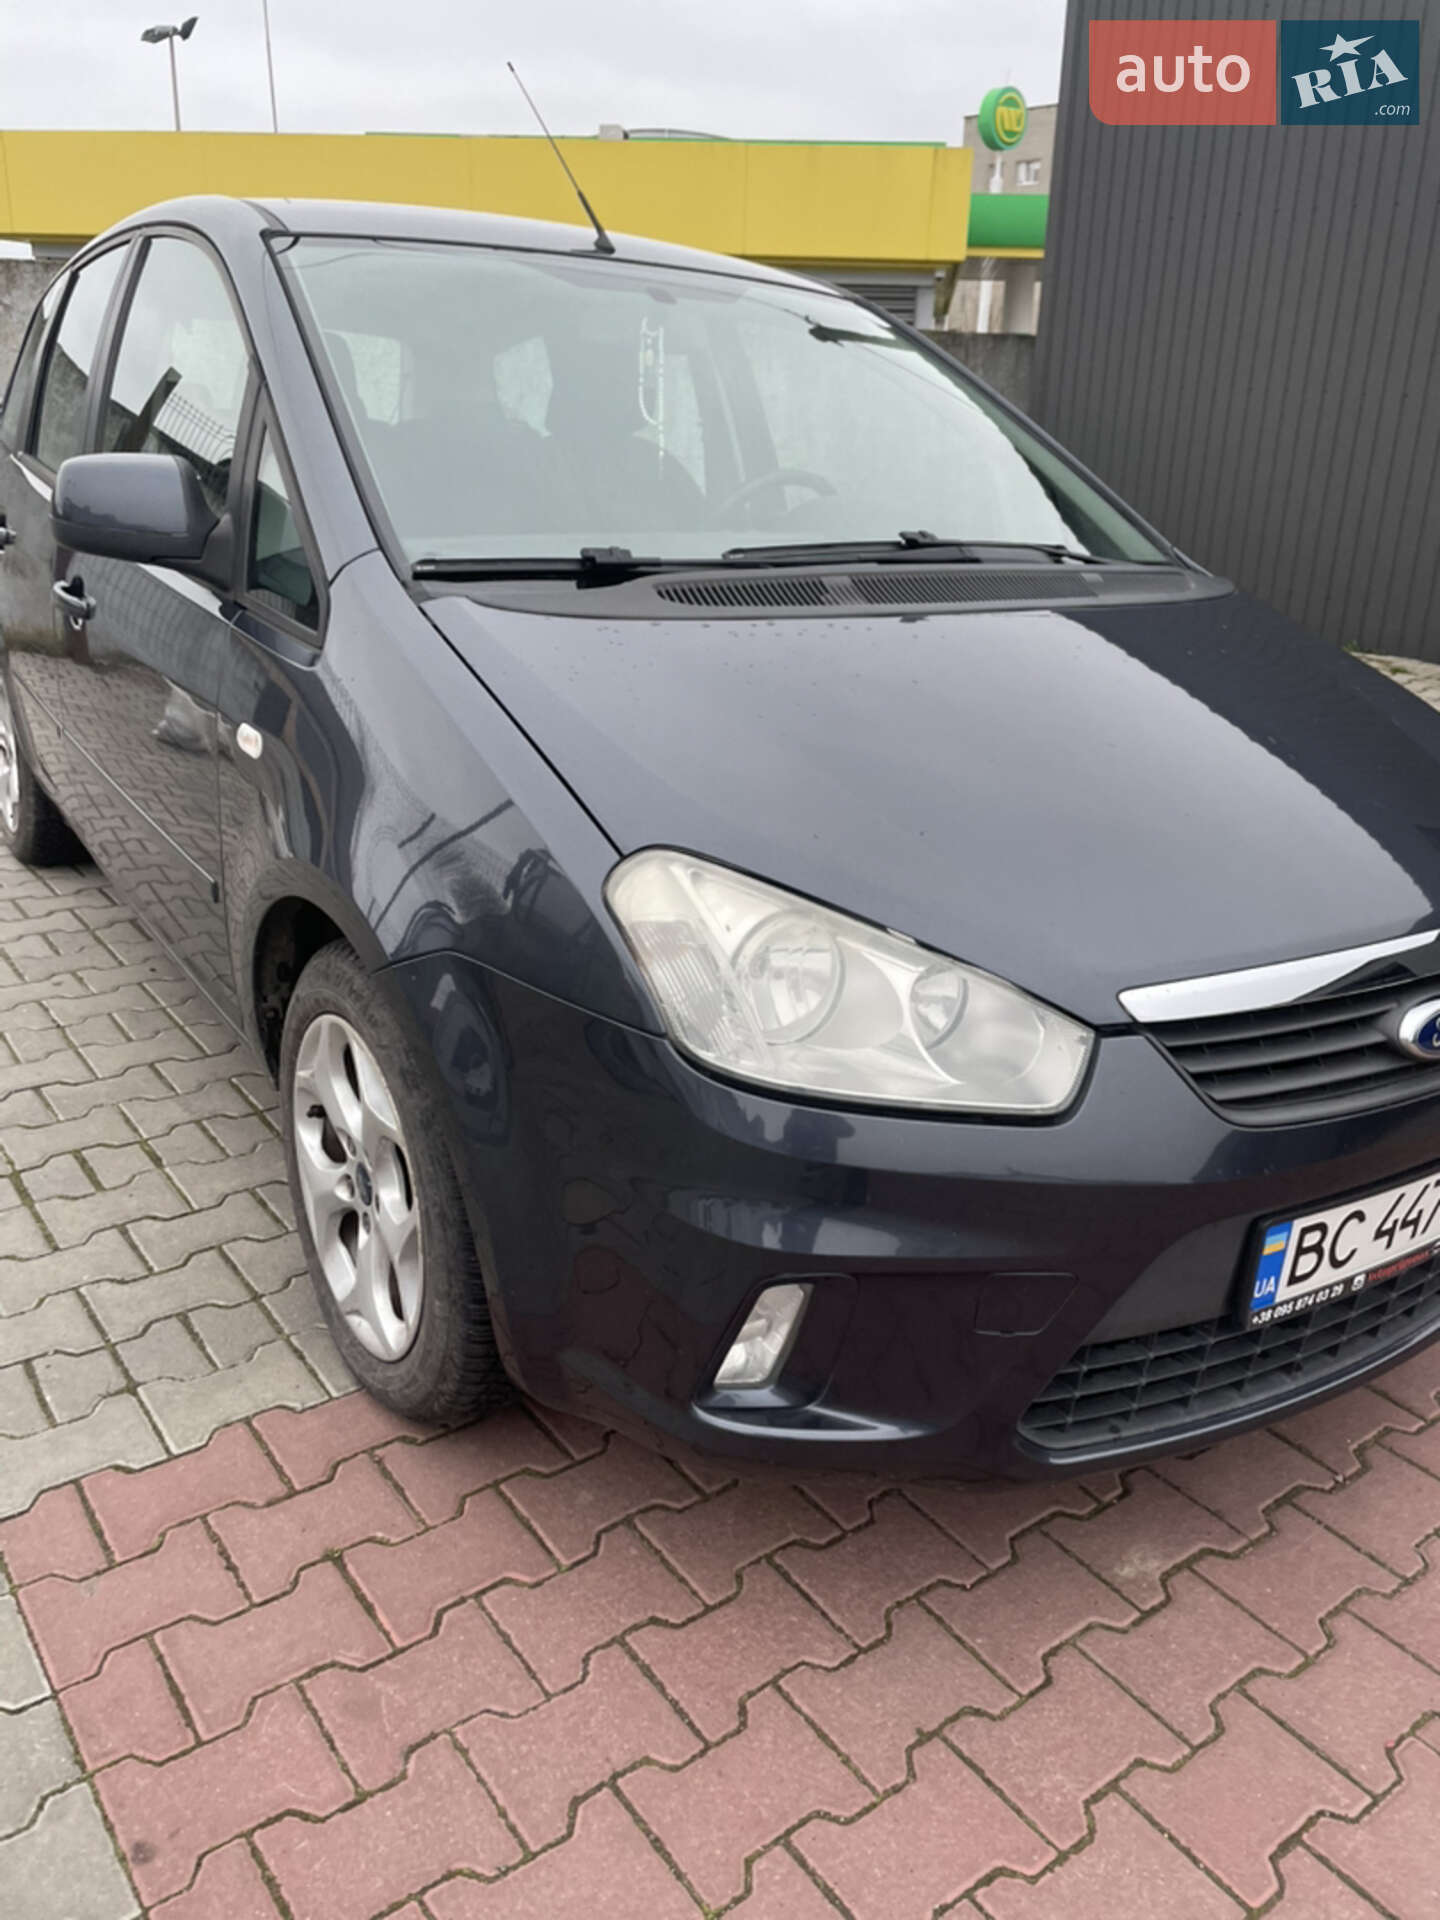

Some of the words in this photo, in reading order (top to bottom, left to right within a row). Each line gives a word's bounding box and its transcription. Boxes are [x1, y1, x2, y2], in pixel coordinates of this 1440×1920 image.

[1286, 1209, 1366, 1287] BC
[1253, 1275, 1276, 1298] UA
[1252, 1308, 1273, 1325] +38
